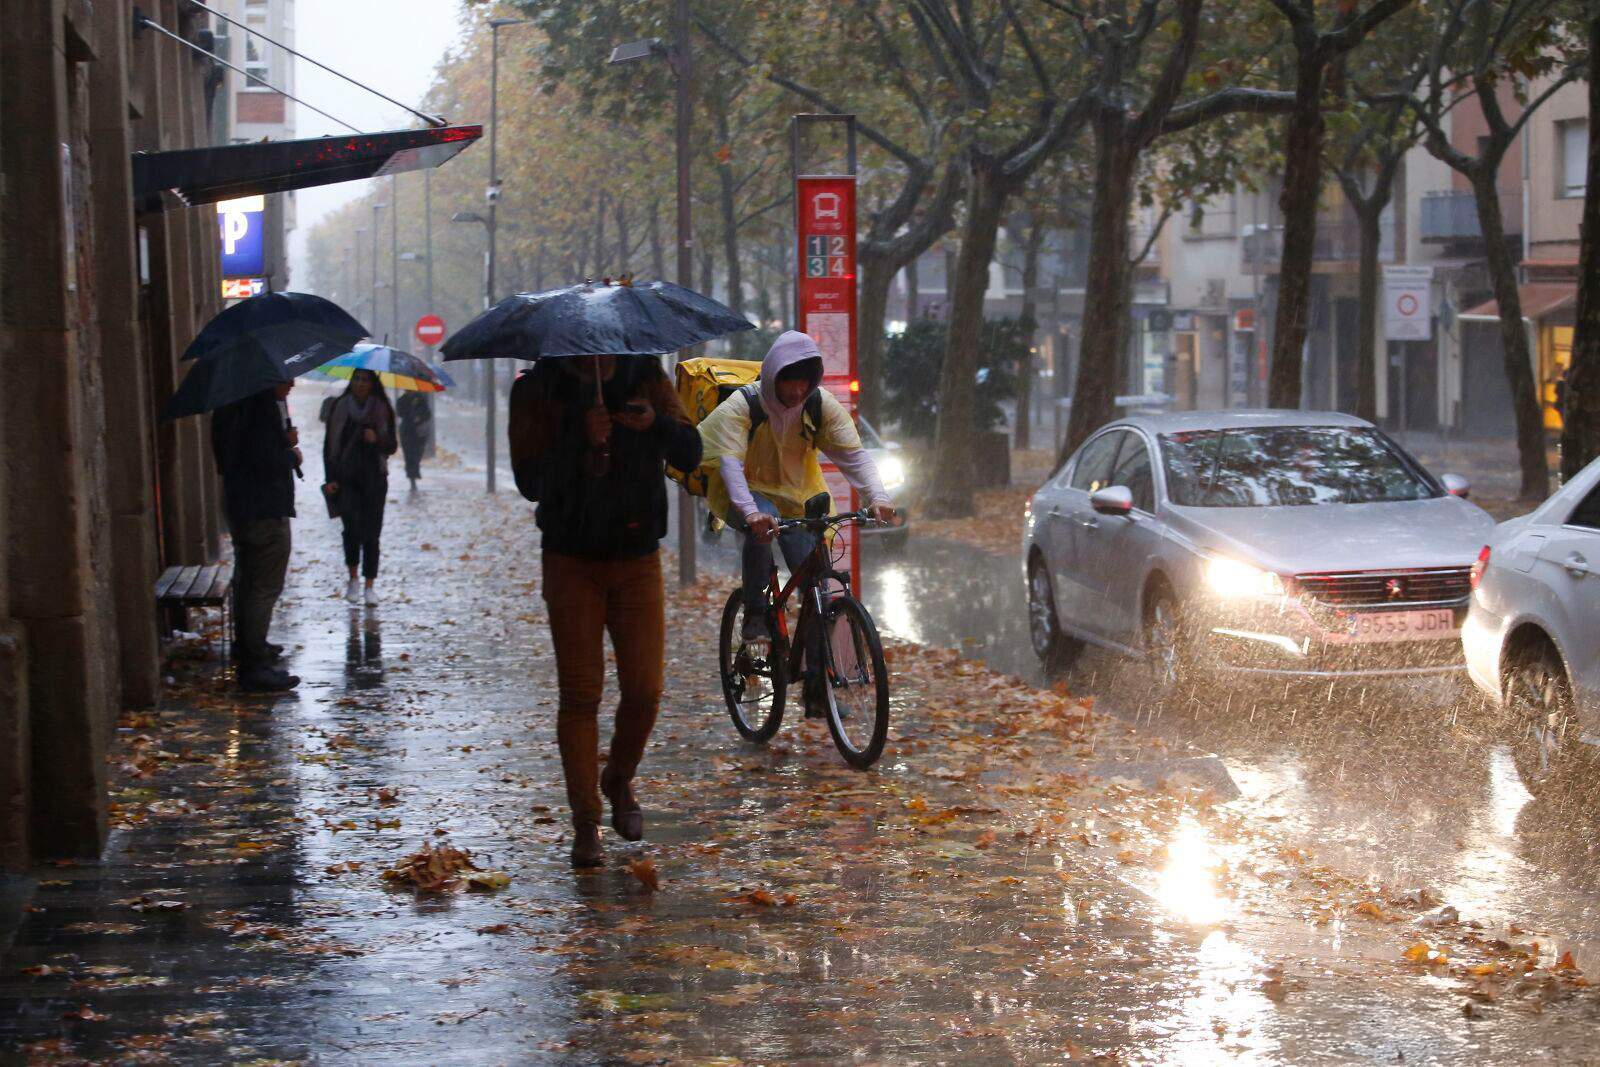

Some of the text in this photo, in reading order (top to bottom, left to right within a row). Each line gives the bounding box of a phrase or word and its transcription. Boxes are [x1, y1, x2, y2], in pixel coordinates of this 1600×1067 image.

[224, 212, 248, 254] P
[811, 236, 845, 256] 1 2
[811, 257, 845, 277] 3 4
[1414, 612, 1450, 631] JDH
